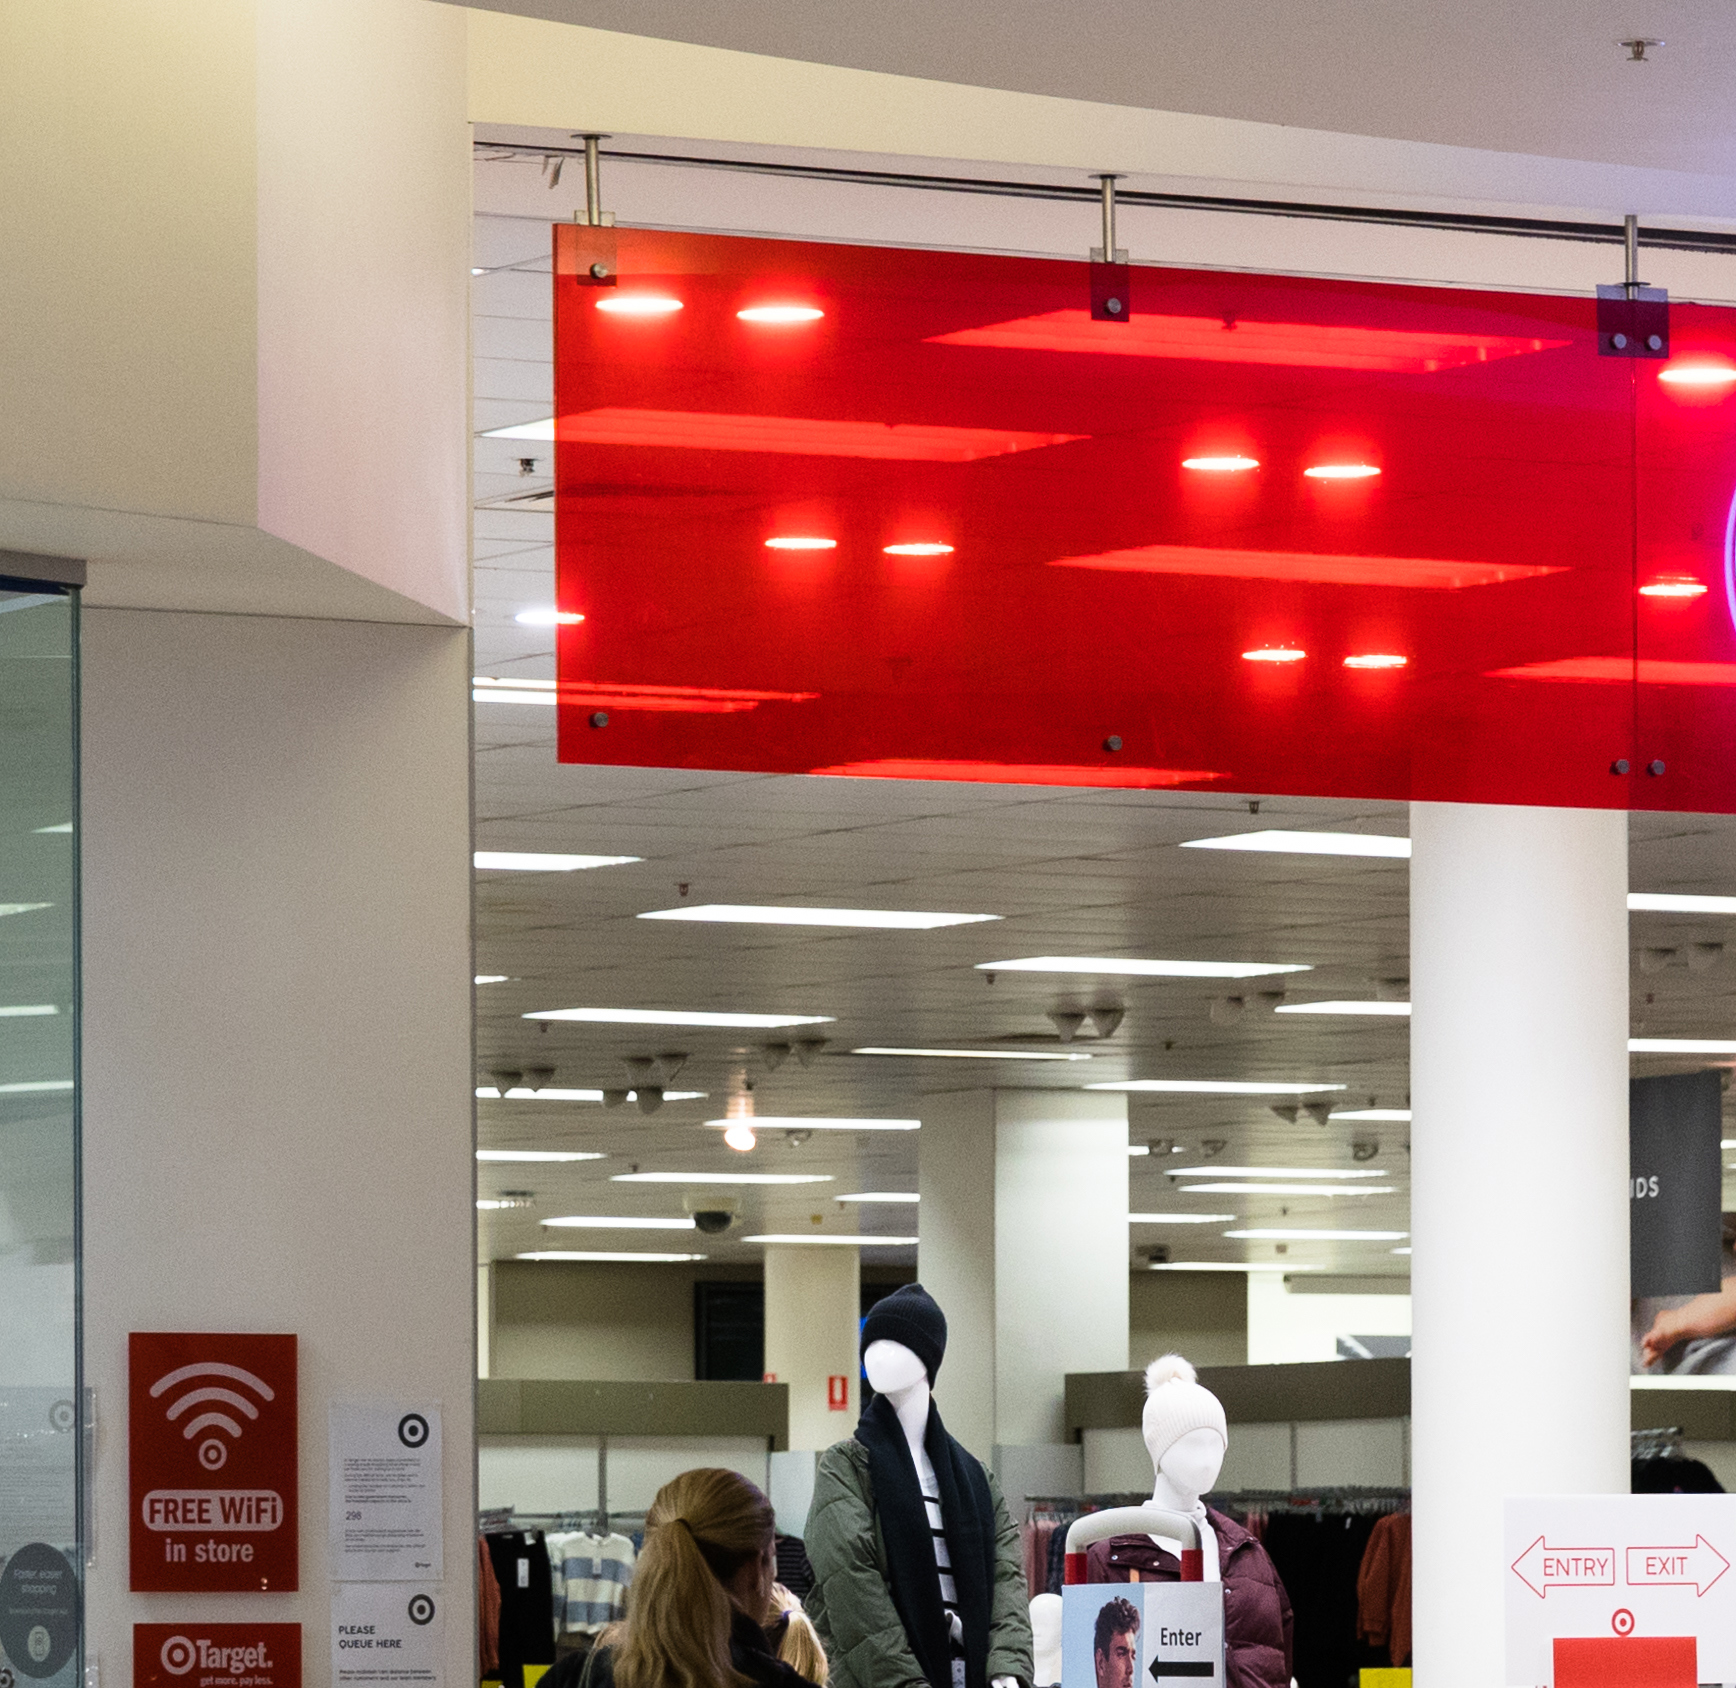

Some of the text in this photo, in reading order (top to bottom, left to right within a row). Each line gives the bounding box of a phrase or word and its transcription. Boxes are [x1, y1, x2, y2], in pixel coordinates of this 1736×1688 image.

[149, 1497, 278, 1524] FREE WiFi
[165, 1538, 254, 1562] in store
[1543, 1557, 1688, 1577] ENTRY EXIT
[338, 1625, 376, 1635] PLEASE
[1160, 1627, 1202, 1646] Enter
[338, 1639, 402, 1649] QUEUE HERE
[196, 1639, 274, 1674] Target.
